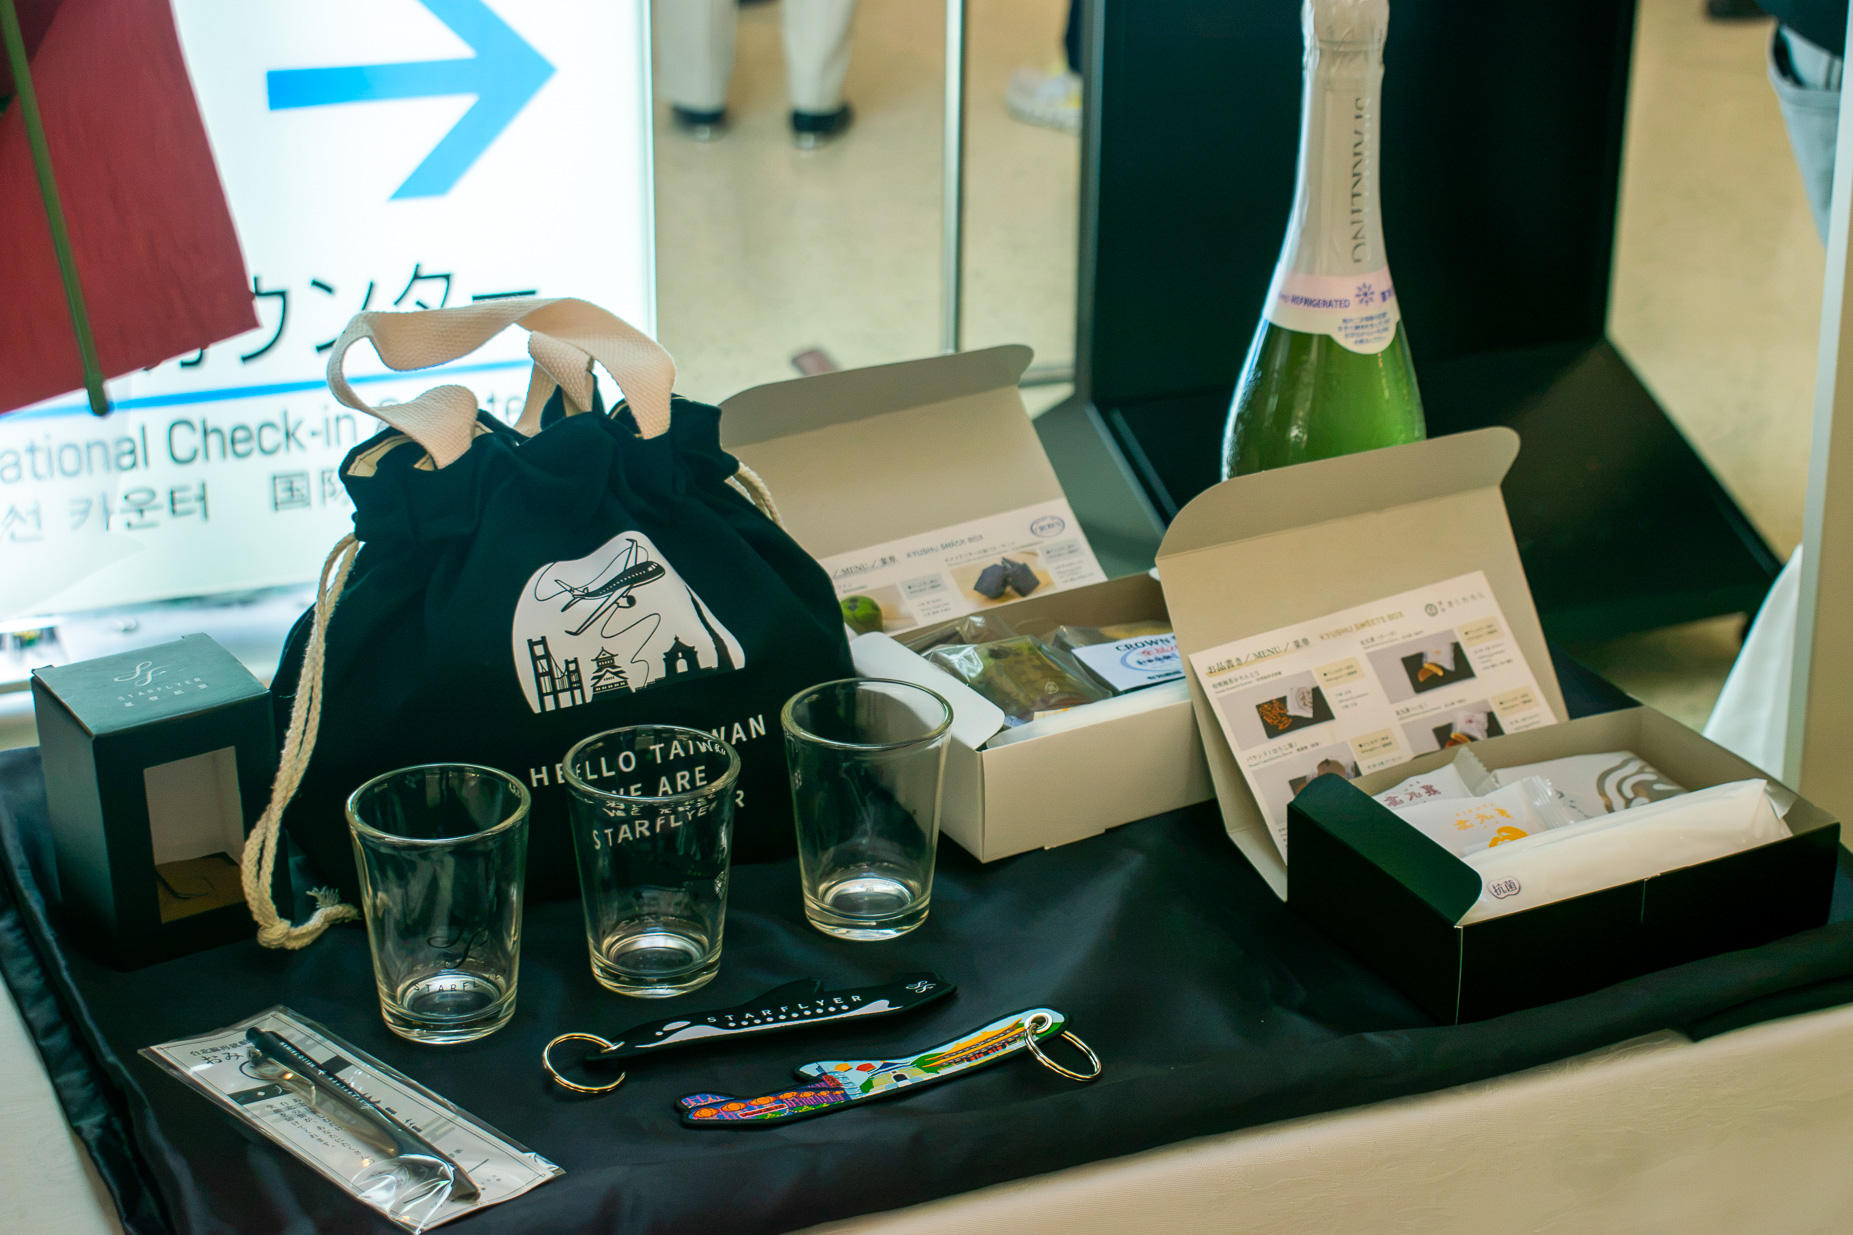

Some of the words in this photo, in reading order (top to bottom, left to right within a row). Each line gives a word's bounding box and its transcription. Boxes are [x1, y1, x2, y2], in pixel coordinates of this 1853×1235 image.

[168, 402, 358, 466] Check-in
[68, 481, 208, 533] 카운터
[1115, 638, 1170, 653] CROWN
[1252, 645, 1283, 661] MENU
[529, 750, 637, 788] HELLO
[649, 714, 767, 764] TAIWAN
[658, 765, 708, 797] ARE
[1491, 879, 1518, 897] 抗菌
[707, 994, 863, 1024] STARFLYER
